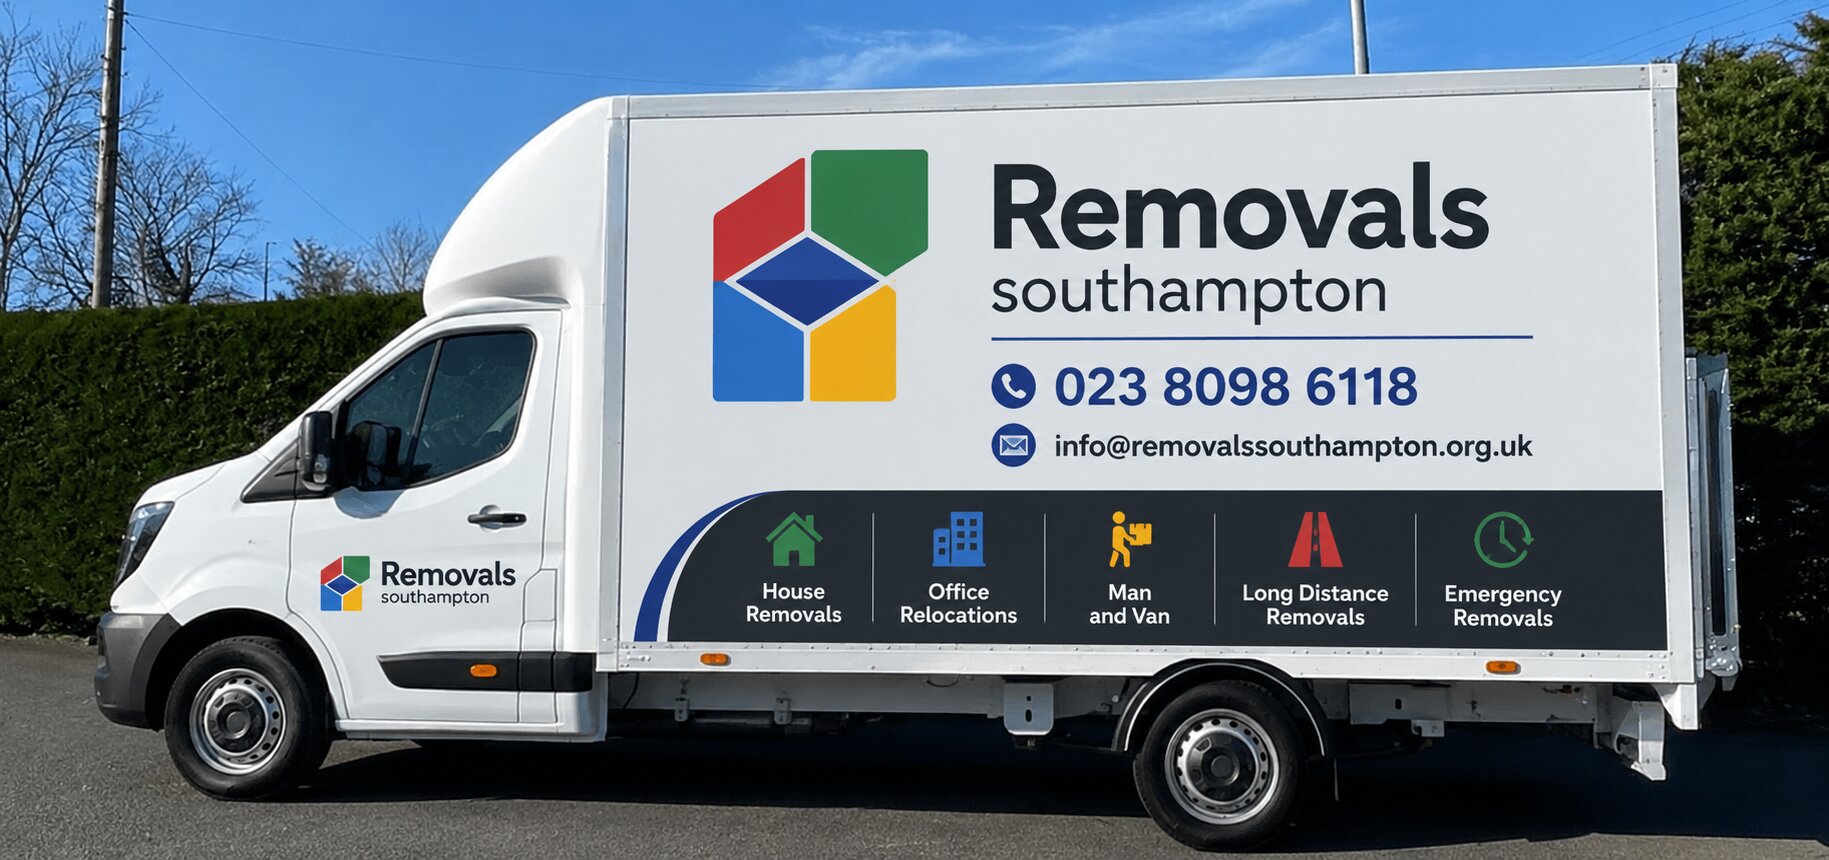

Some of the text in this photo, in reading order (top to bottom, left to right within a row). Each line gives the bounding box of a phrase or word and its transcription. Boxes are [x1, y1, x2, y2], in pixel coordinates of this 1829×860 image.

[994, 161, 1489, 250] Removals
[992, 264, 1385, 325] southampton
[1056, 367, 1417, 406] 023 8098 6118
[1056, 434, 1533, 462] info@removalssouthampton.org.uk
[382, 561, 516, 586] Removals
[382, 589, 489, 607] southampton
[763, 583, 825, 599] House
[929, 583, 989, 600] Office
[1109, 584, 1151, 600] Man
[1244, 584, 1388, 605] Long Distance
[1446, 585, 1562, 607] Emergency
[747, 605, 841, 622] Removals
[901, 606, 1017, 623] Relocations
[1090, 607, 1169, 624] and Van
[1267, 608, 1365, 625] Removals
[1455, 609, 1553, 626] Removals
